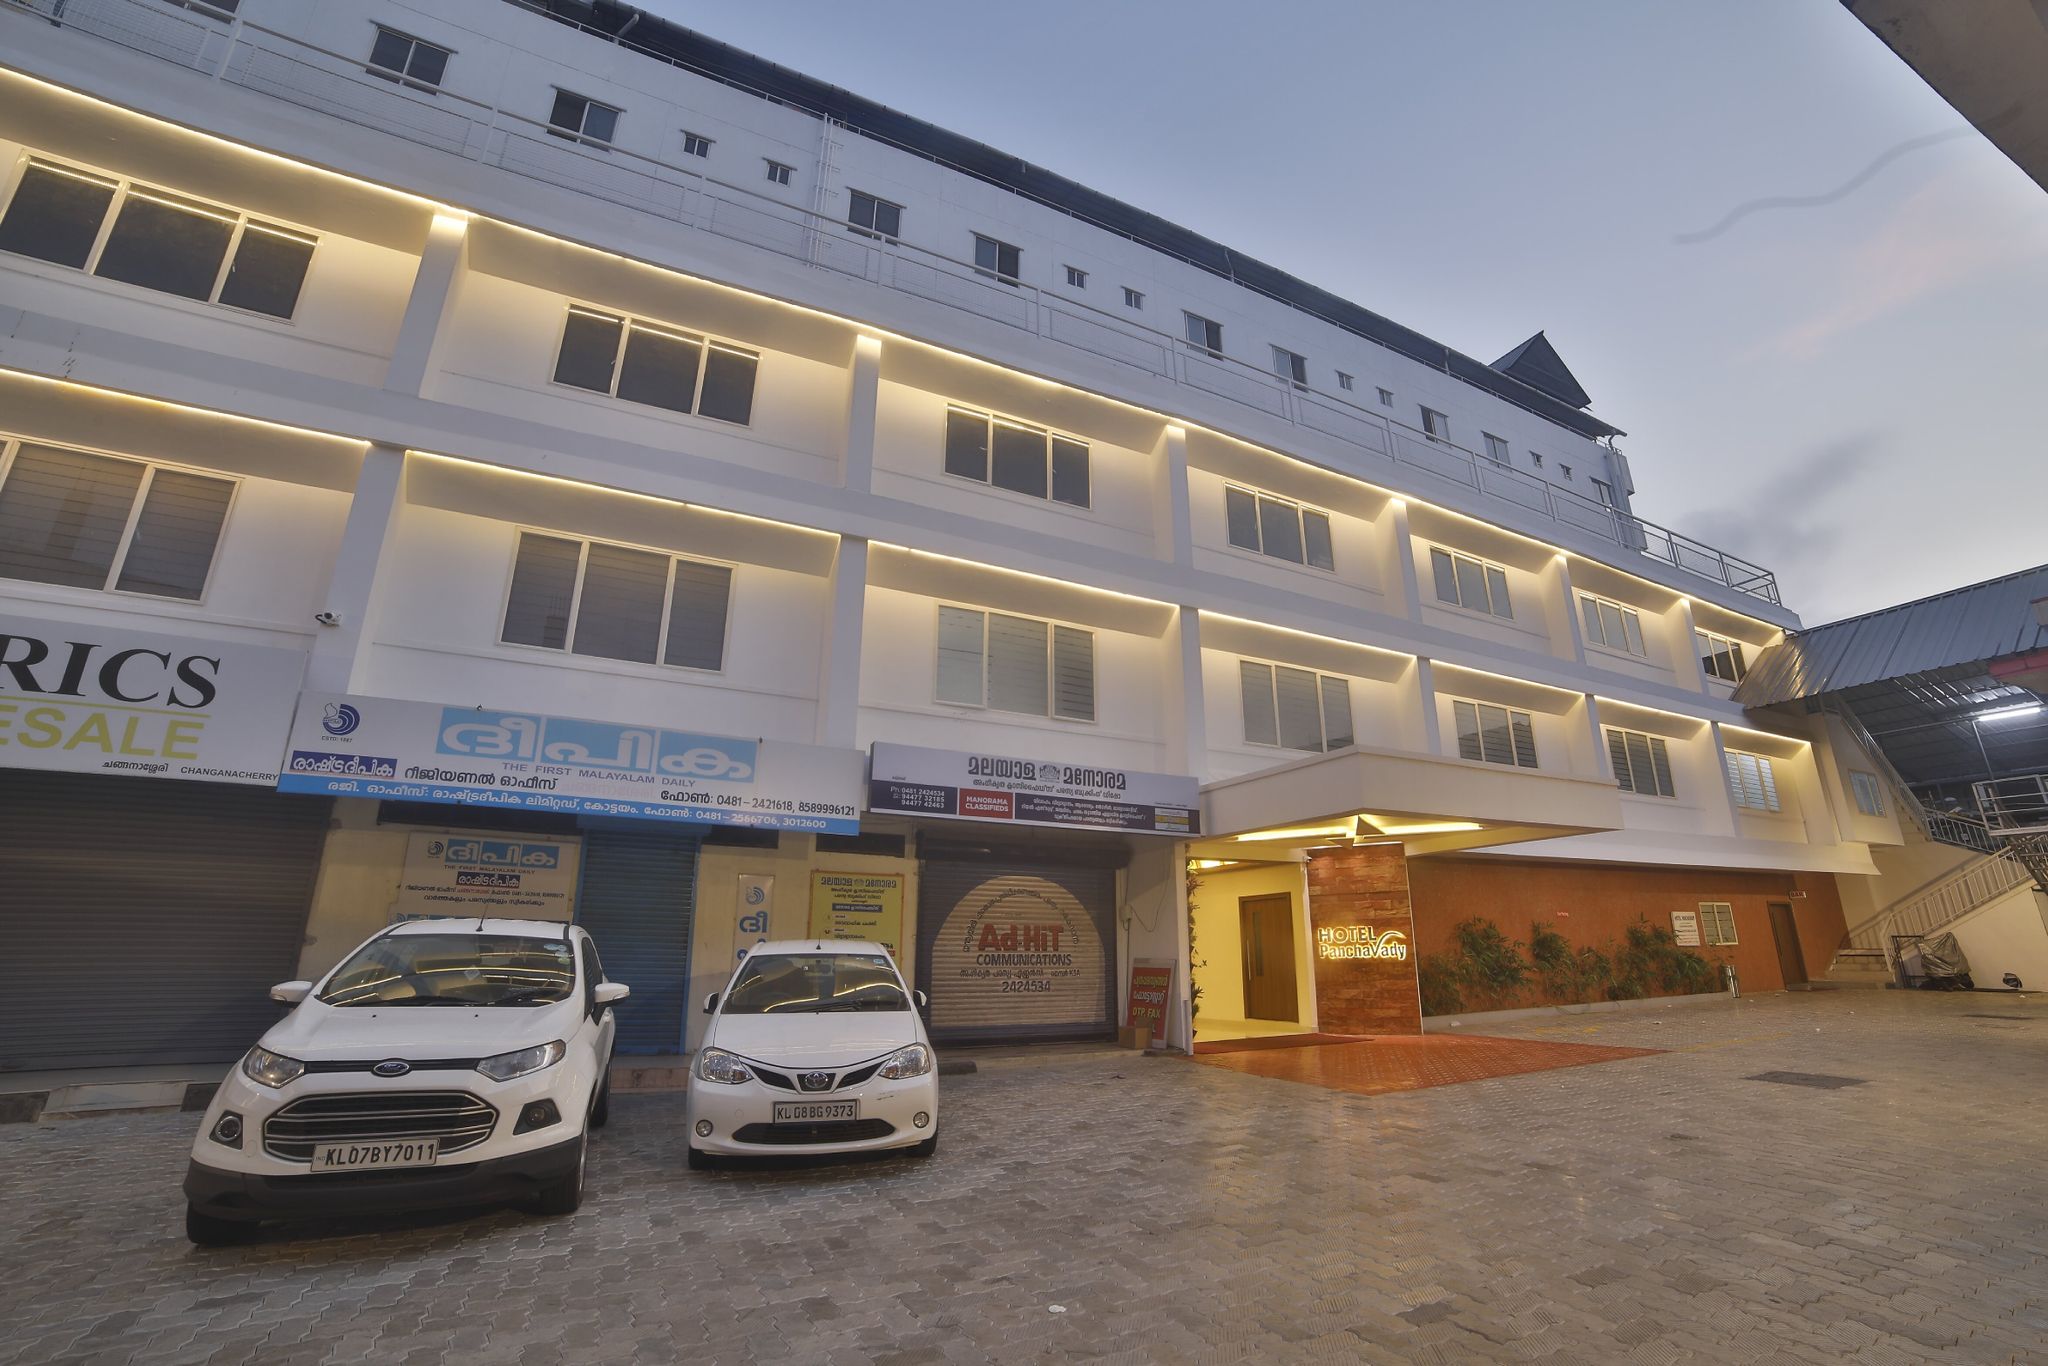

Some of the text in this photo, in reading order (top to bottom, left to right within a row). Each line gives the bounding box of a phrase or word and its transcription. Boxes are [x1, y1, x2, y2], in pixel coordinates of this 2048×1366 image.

[440, 715, 753, 781] ദീപിക
[180, 766, 278, 781] CHANGANACHERRY
[501, 773, 559, 790] ഓഫീസ്
[502, 762, 696, 788] THE FIRST MALAYALAM DAILY
[968, 756, 1127, 791] മലയാള മനോരമ
[798, 801, 855, 817] 8589996121
[965, 803, 1009, 812] CLASSIFIEDS
[966, 795, 1009, 806] MANORAMA
[783, 817, 827, 829] 3012600
[977, 924, 1018, 952] Ad
[1317, 925, 1377, 944] HOTEL
[1319, 937, 1407, 961] PanchaVady
[977, 953, 1072, 967] COMMUNICATIONS
[1001, 981, 1051, 993] 2424534
[325, 1143, 435, 1166] KL07BY7011
